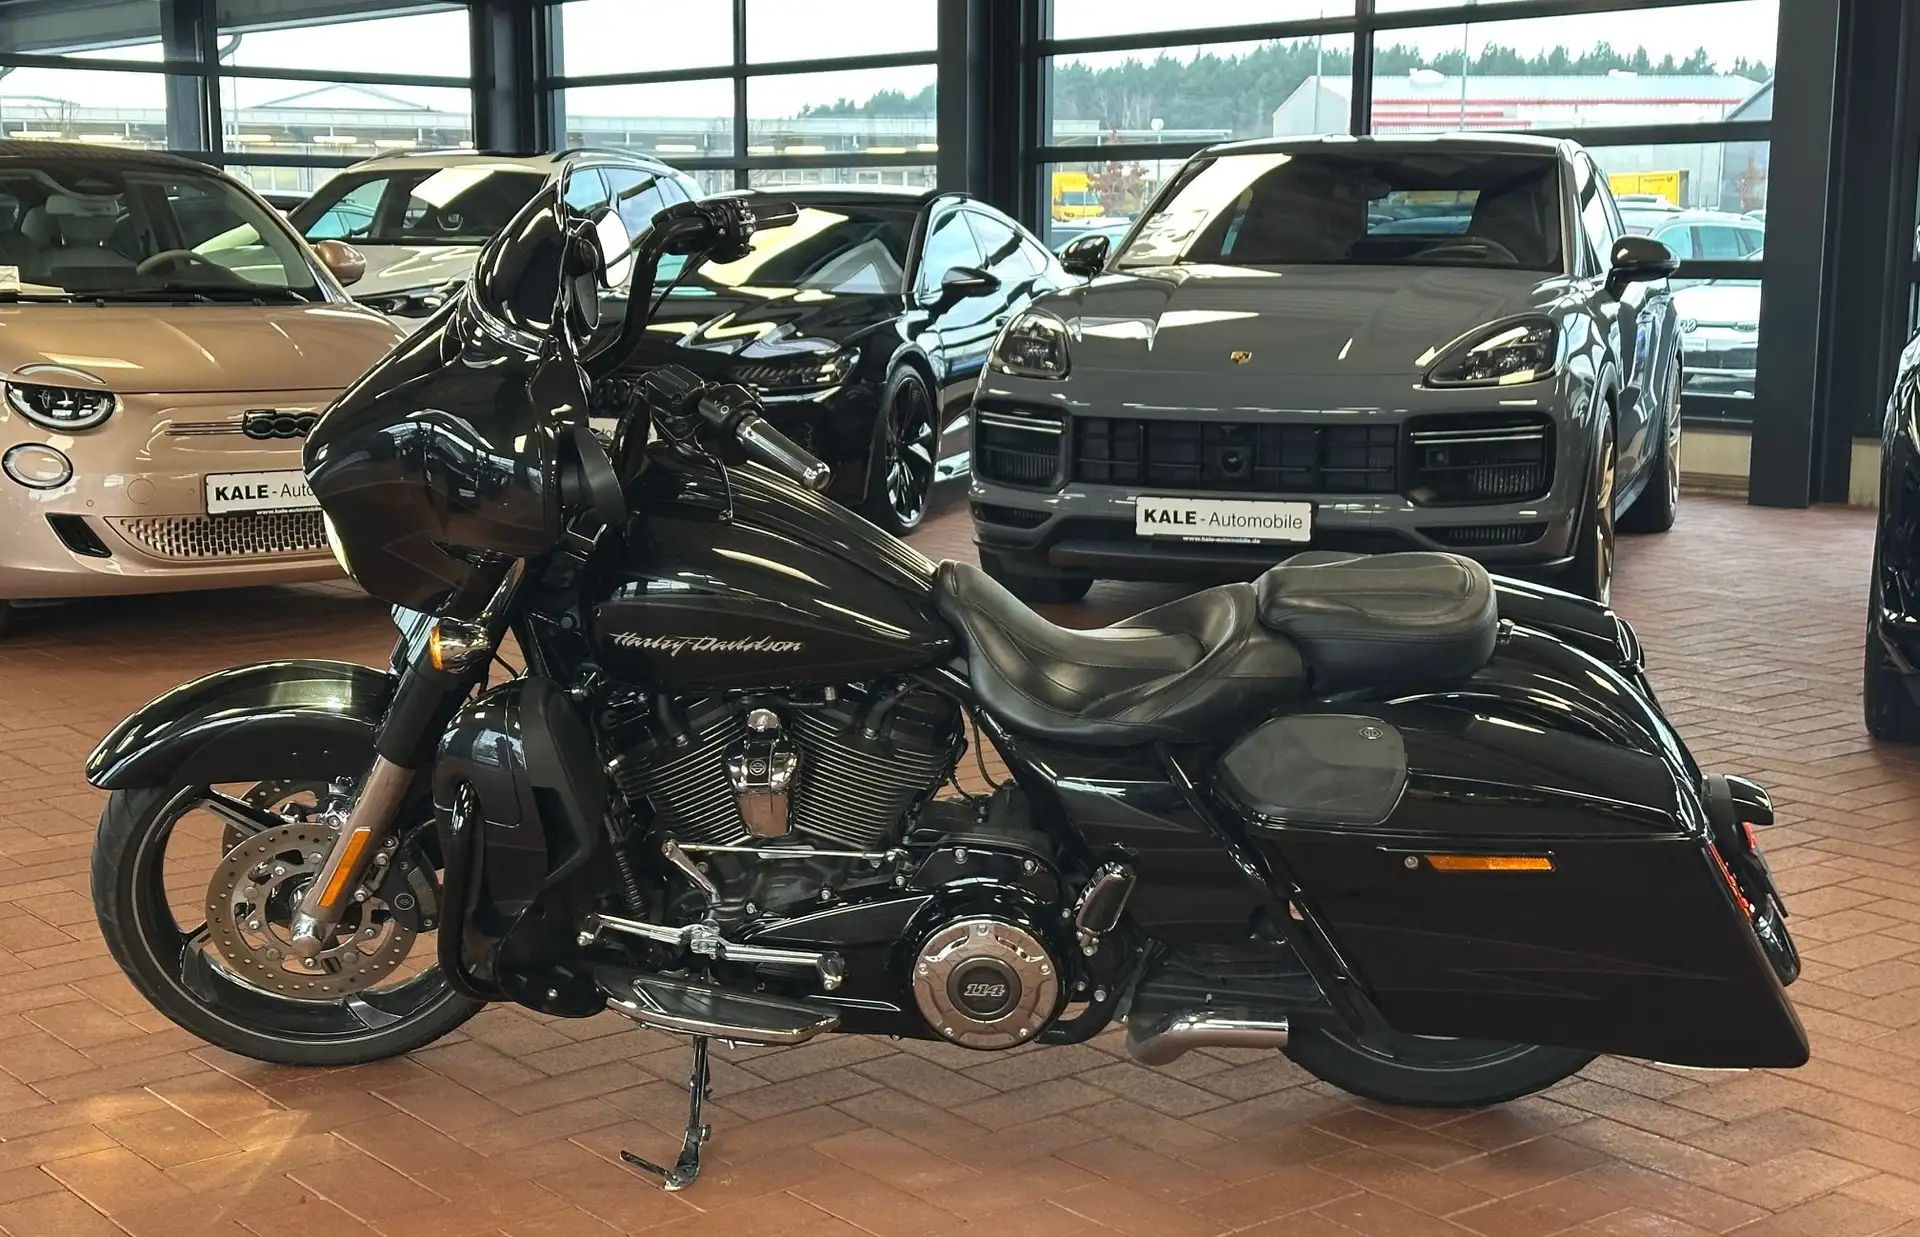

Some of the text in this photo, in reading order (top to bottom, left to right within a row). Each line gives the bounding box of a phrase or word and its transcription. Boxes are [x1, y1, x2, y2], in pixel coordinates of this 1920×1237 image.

[215, 484, 269, 501] KALE
[1144, 509, 1197, 525] KALE
[1209, 511, 1303, 530] Automobile
[963, 983, 1006, 997] 114
